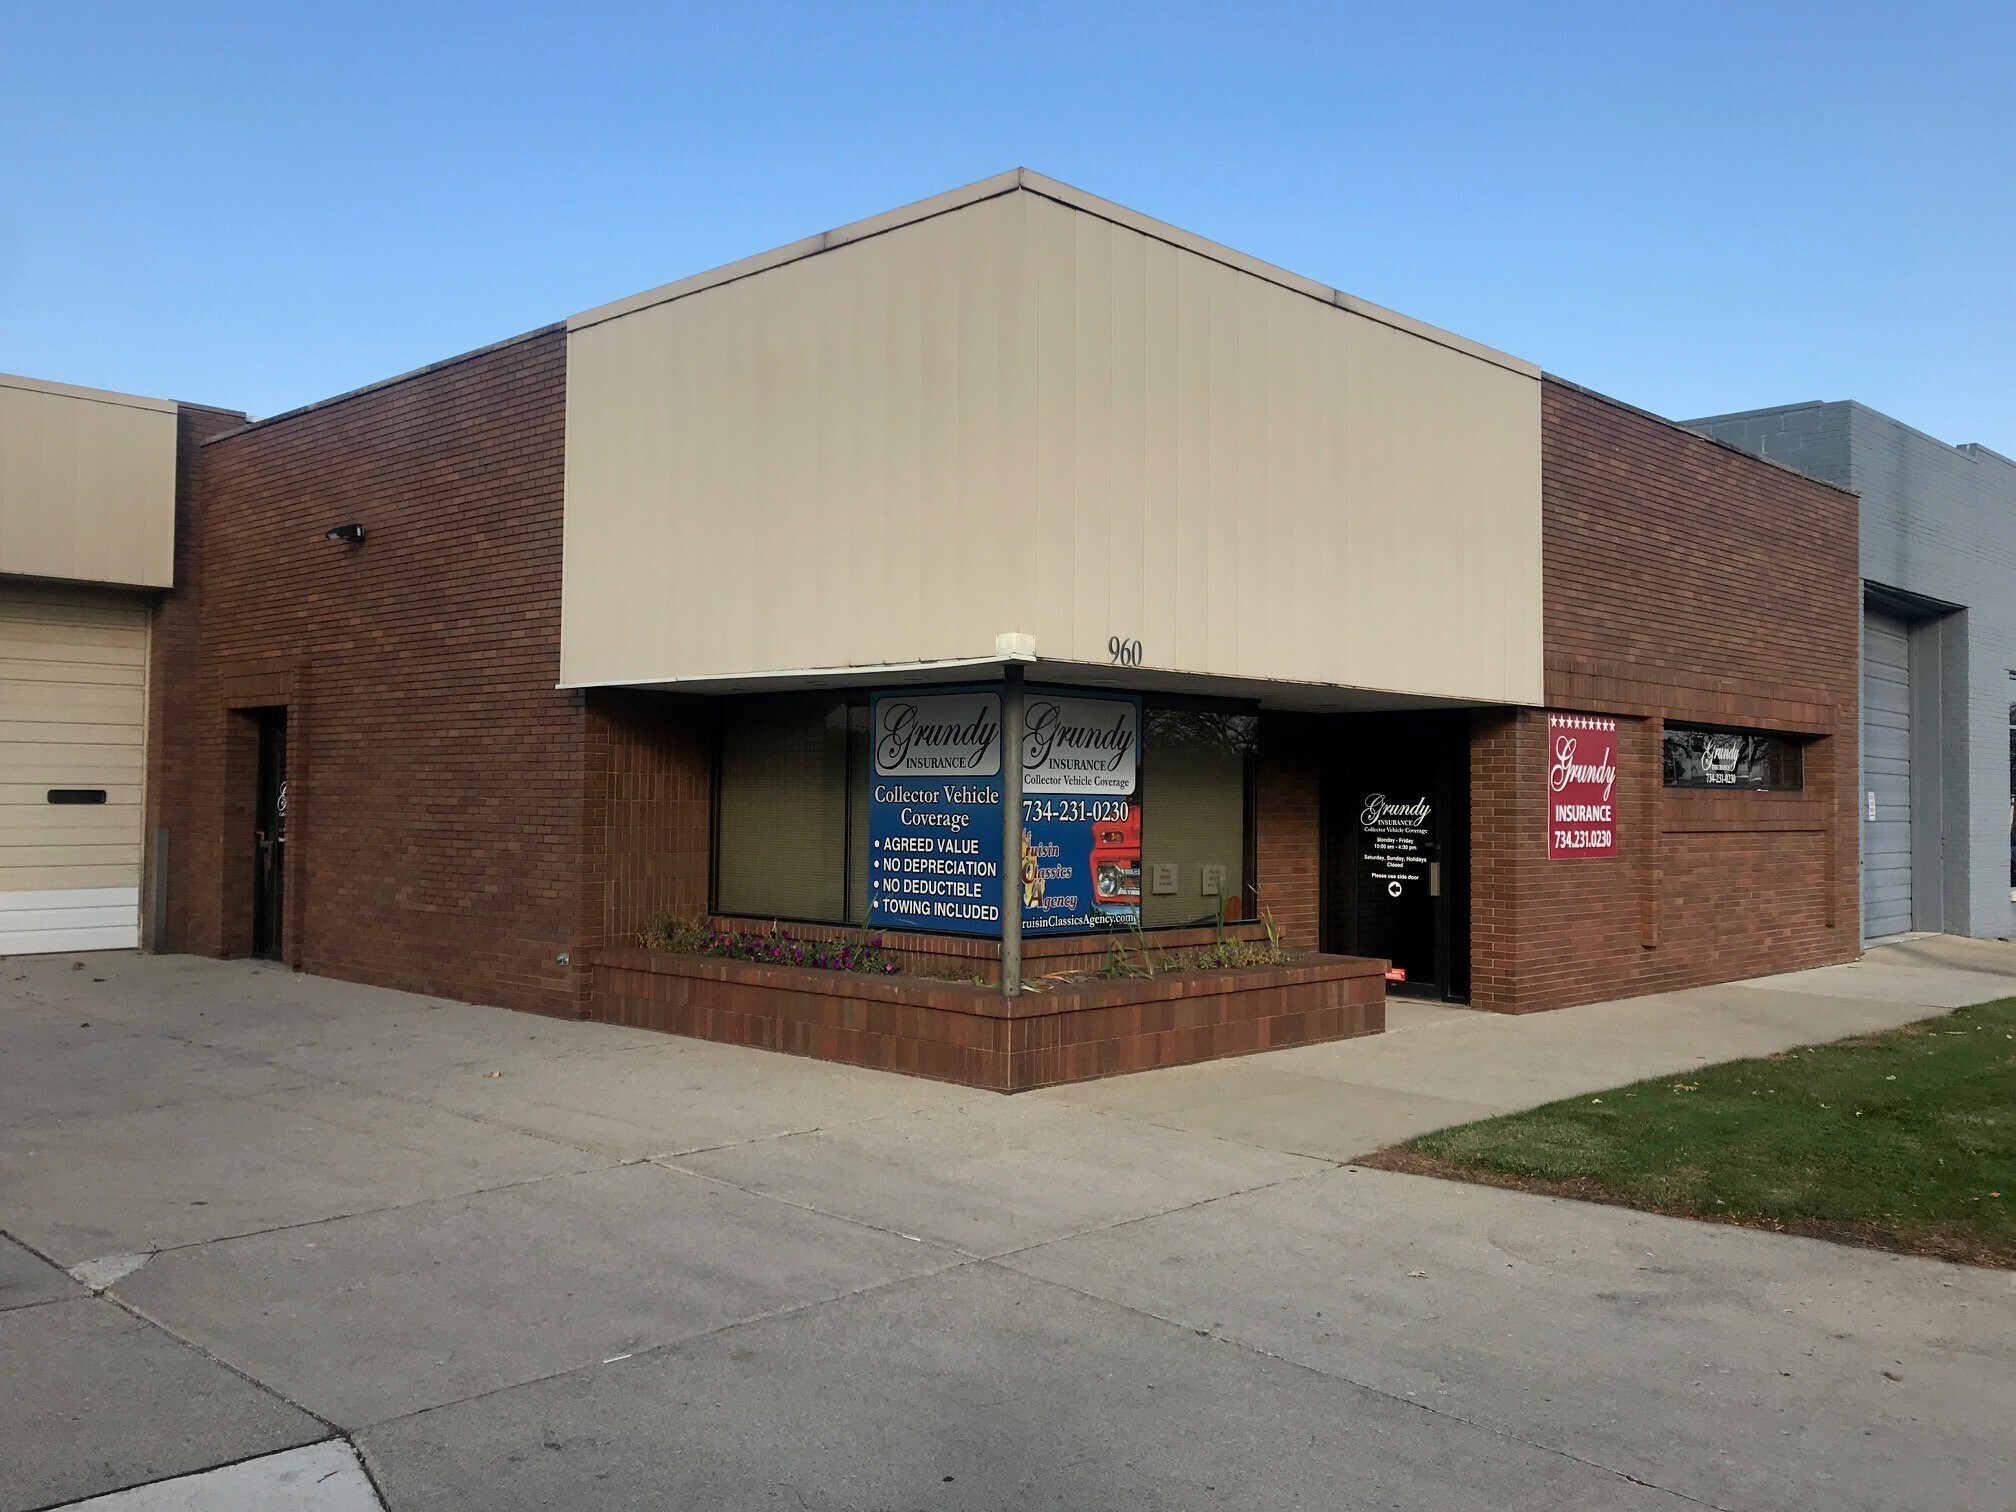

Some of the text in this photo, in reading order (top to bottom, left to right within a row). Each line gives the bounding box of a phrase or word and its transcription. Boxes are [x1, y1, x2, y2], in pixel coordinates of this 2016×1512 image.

[1109, 636, 1142, 666] 960
[877, 703, 999, 769] Grundy
[1023, 702, 1134, 771] Grundy
[906, 757, 966, 769] INSURANCE
[1702, 737, 1739, 771] Grundy
[1049, 758, 1106, 771] INSURANCE
[1551, 735, 1616, 801] Grundy
[1024, 774, 1129, 788] Collector Vehicle Coverage
[874, 785, 999, 804] Collector Vehicle
[901, 808, 970, 832] Coverage
[1023, 801, 1129, 822] 734-231-0230
[1360, 793, 1431, 827] Grundy
[1555, 805, 1611, 822] INSURANCE
[884, 838, 979, 854] AGREED VALUE
[1555, 830, 1611, 848] 734.231.0230
[1022, 842, 1060, 858] ruisin
[883, 858, 996, 877] NO DEPRECIATION
[883, 878, 982, 898] NO DEDUCTIBLE
[1027, 880, 1077, 911] Agency
[883, 899, 999, 921] TOWING INCLUDED
[1022, 914, 1134, 929] ruisinClassicsAgency.com
